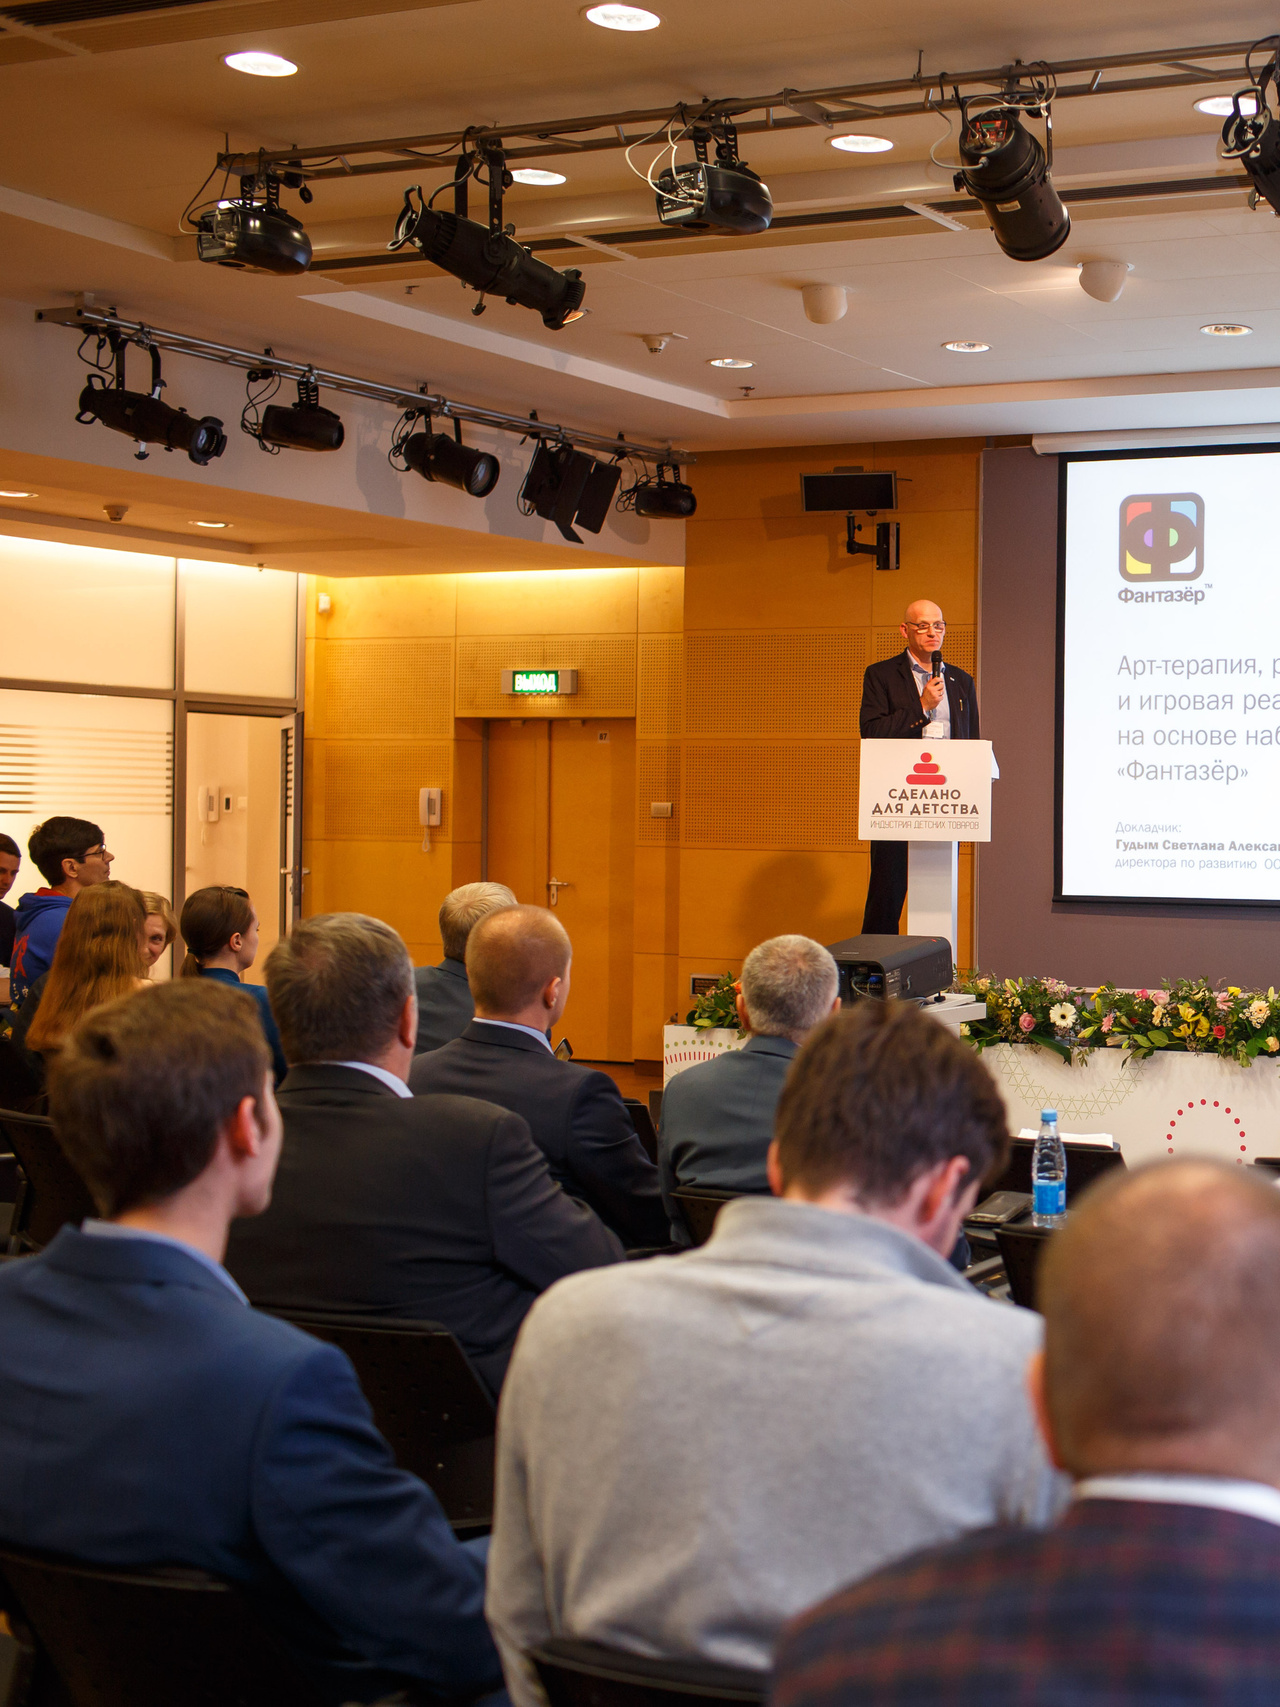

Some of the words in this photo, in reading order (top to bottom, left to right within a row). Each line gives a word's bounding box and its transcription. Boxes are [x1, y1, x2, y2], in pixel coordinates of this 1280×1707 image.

[1117, 586, 1205, 605] Фантазёр
[1117, 655, 1263, 680] Арт-терапия,
[514, 673, 557, 692] ВЫХОД
[1118, 695, 1131, 711] и
[1140, 693, 1234, 715] игровая
[1118, 729, 1145, 746] на
[1153, 728, 1237, 746] основе
[1117, 759, 1249, 785] «Фантазёр»
[888, 788, 961, 801] СДЕЛАНО
[872, 803, 904, 815] ДЛЯ
[910, 803, 979, 816] ДЕТСТВА
[870, 820, 912, 829] ИНДУСТРИЯ
[947, 821, 980, 830] ТОВАРОВ
[1115, 821, 1182, 834] Докладчик:
[1115, 839, 1159, 852] Гудым
[1162, 839, 1225, 852] Светлана
[1115, 857, 1177, 870] директора
[1181, 858, 1195, 869] по
[1199, 857, 1257, 871] развитию
